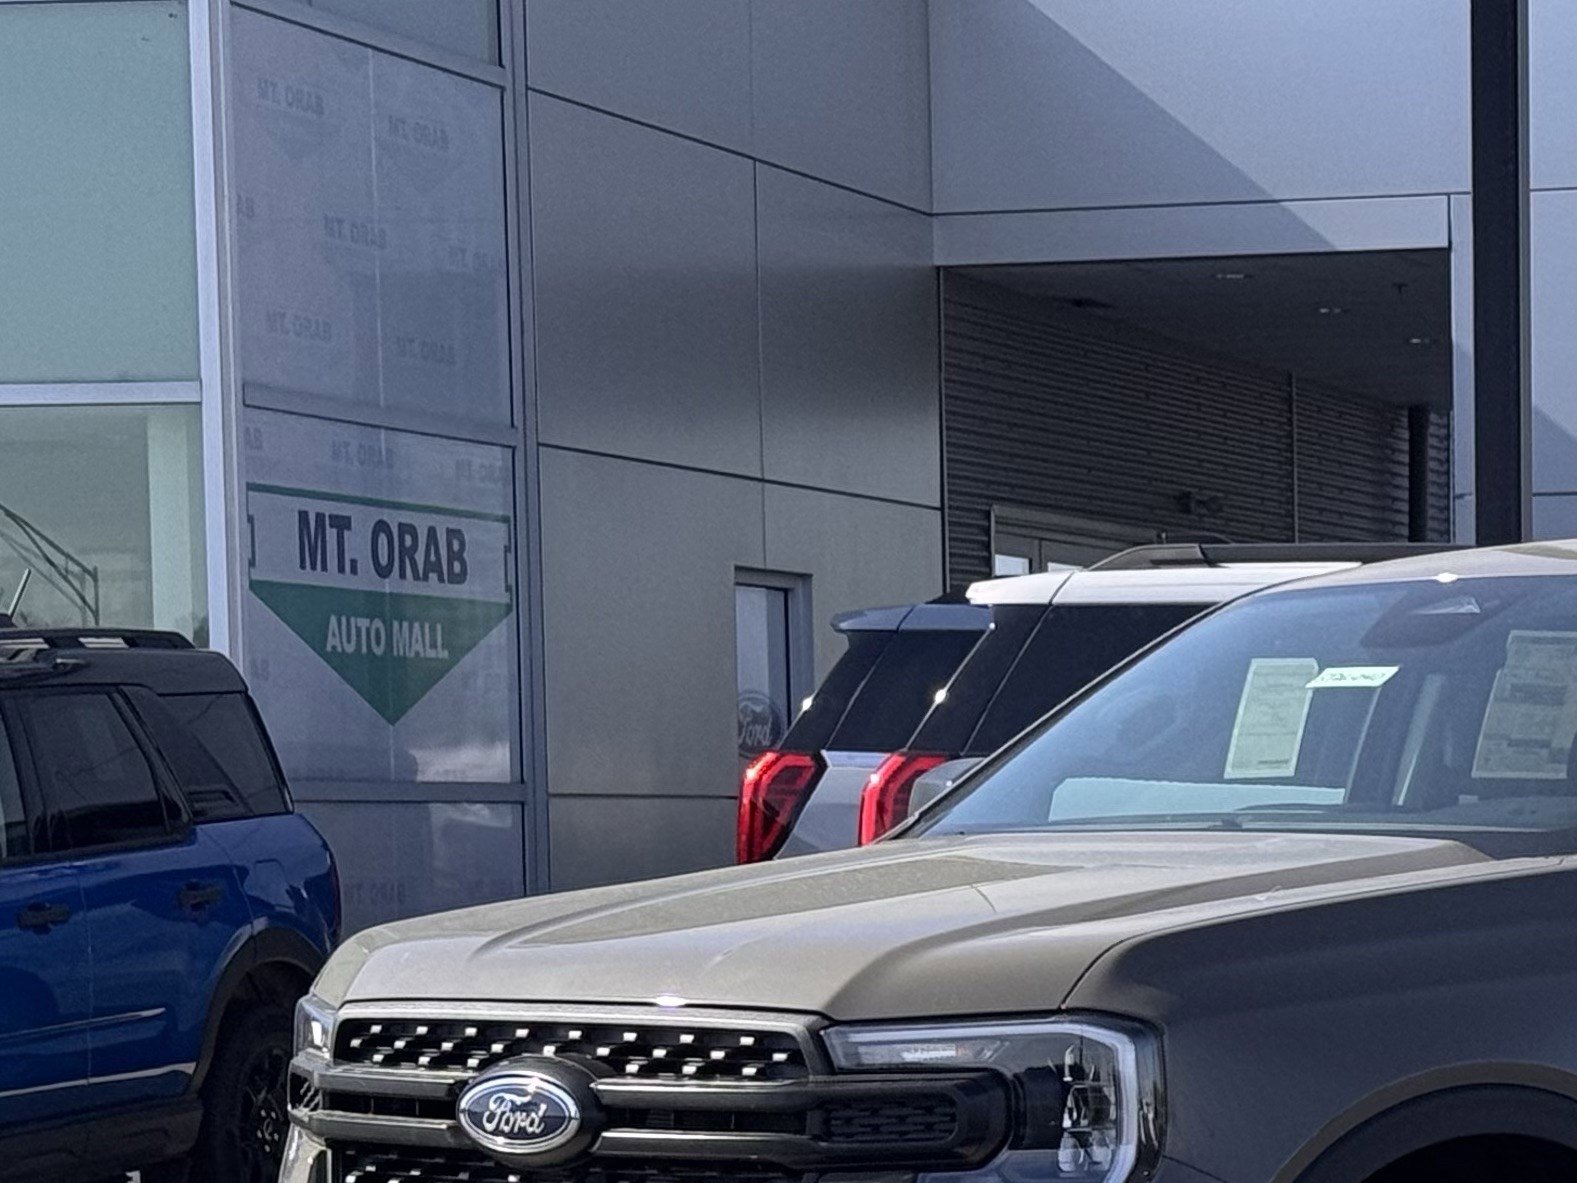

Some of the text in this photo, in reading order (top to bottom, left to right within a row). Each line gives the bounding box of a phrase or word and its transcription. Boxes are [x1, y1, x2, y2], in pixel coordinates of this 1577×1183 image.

[296, 508, 469, 586] MT. ORAB
[325, 613, 449, 659] AUTO MALL
[482, 1092, 548, 1134] Ford
